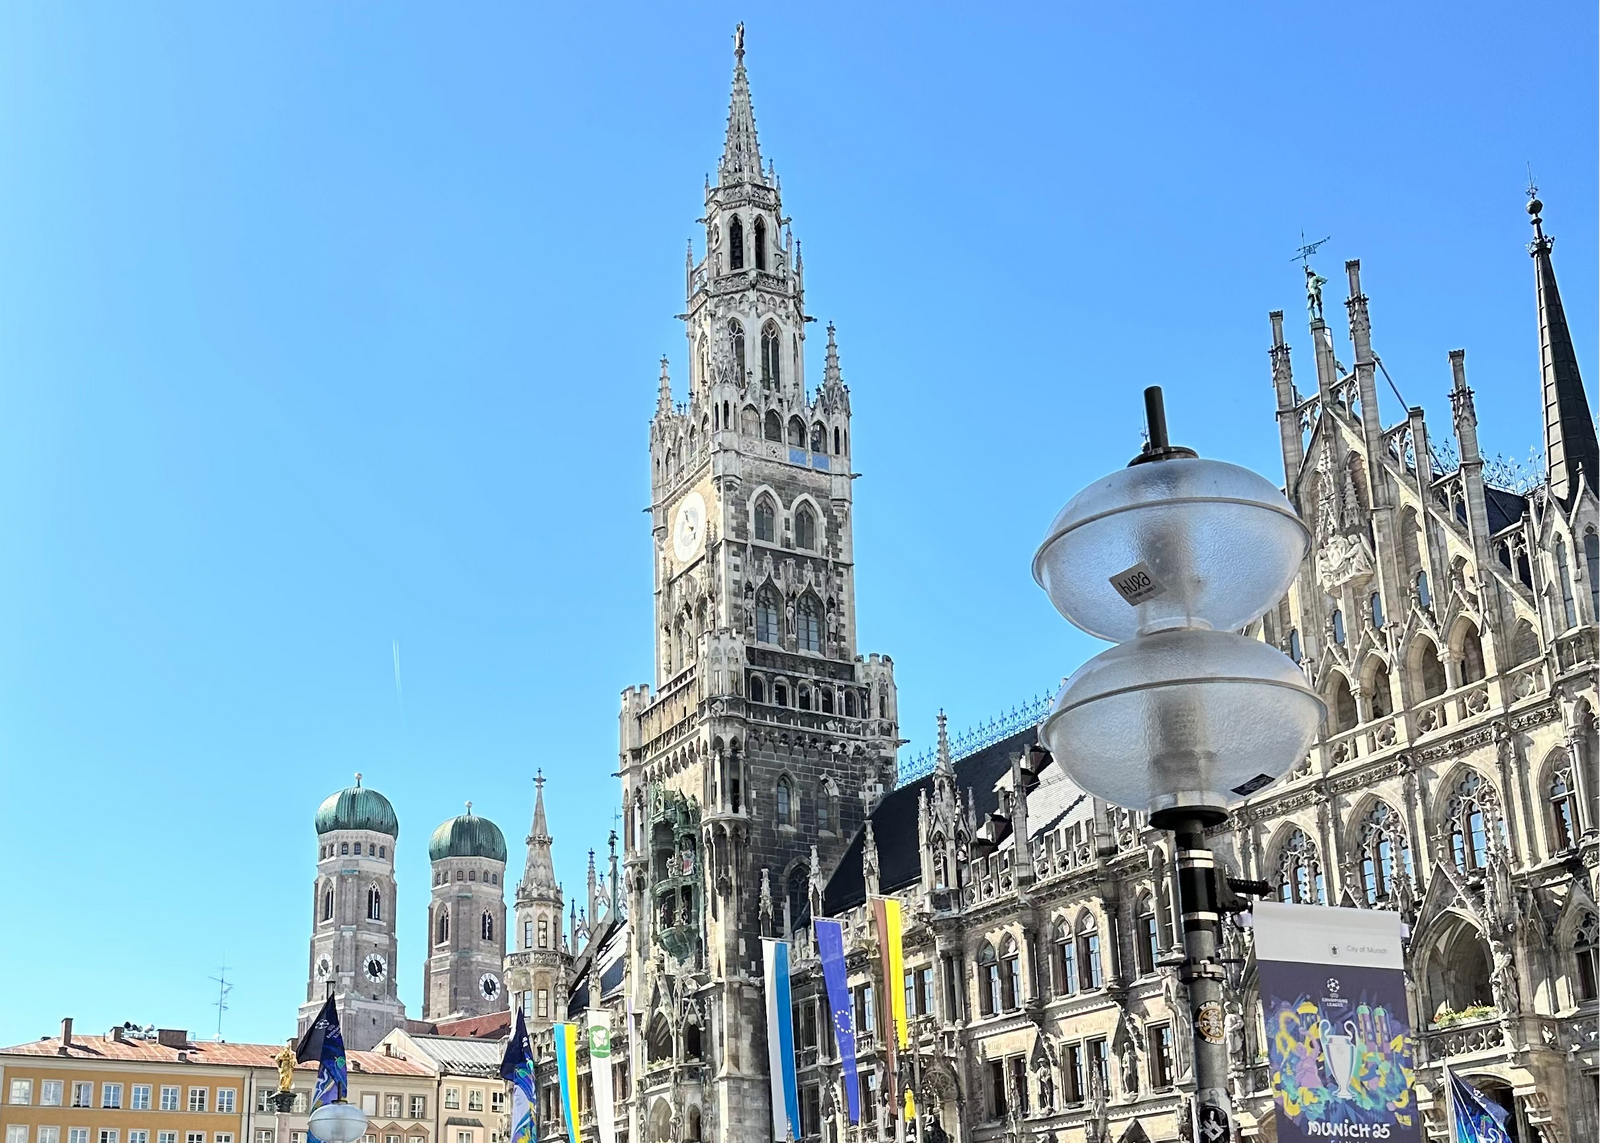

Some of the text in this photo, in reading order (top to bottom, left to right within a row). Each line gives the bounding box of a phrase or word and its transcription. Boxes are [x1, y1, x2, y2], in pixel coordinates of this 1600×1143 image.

[1346, 945, 1358, 953] City
[1367, 946, 1388, 954] Munich
[1372, 1123, 1391, 1139] 25
